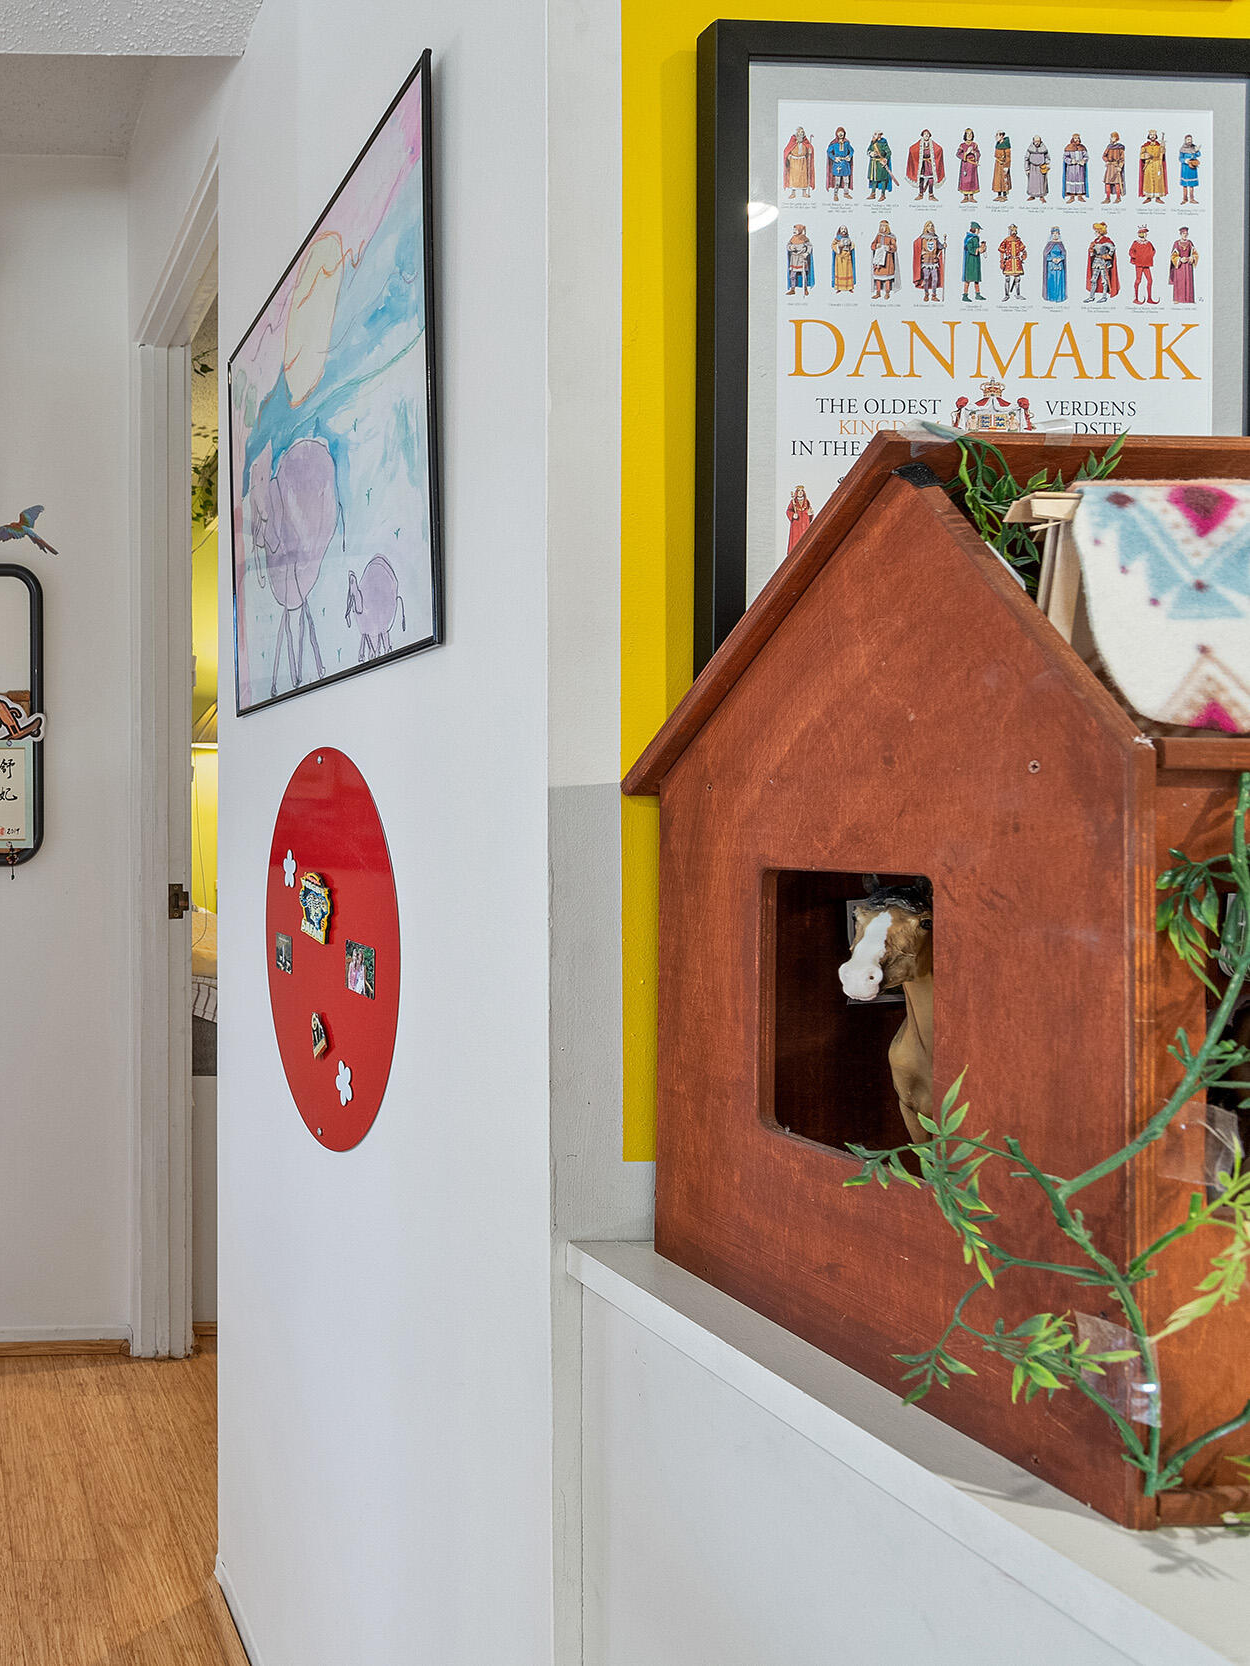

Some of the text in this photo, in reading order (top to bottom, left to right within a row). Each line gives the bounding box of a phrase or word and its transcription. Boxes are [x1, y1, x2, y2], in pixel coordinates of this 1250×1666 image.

[787, 318, 1203, 381] DANMARK
[815, 397, 942, 415] THE OLDEST
[1045, 400, 1137, 417] VERDENS
[791, 440, 863, 457] IN THE
